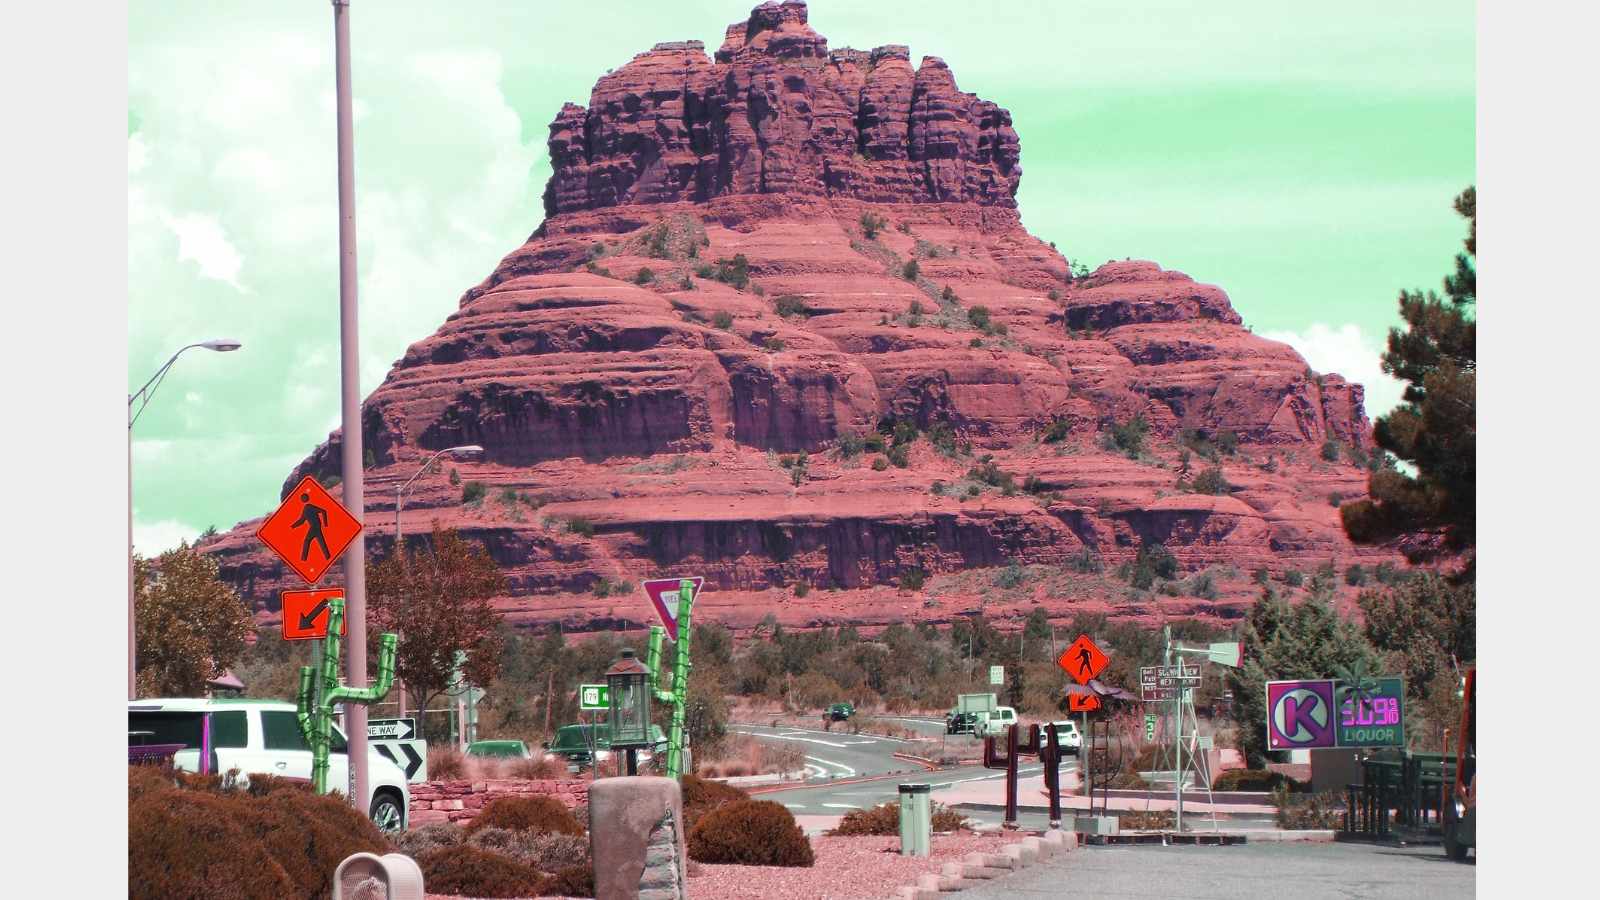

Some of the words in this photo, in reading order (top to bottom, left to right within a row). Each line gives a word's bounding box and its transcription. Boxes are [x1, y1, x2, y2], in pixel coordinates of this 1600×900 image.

[1284, 696, 1327, 740] K
[380, 726, 396, 735] WAY
[1345, 728, 1394, 742] LIQUOR
